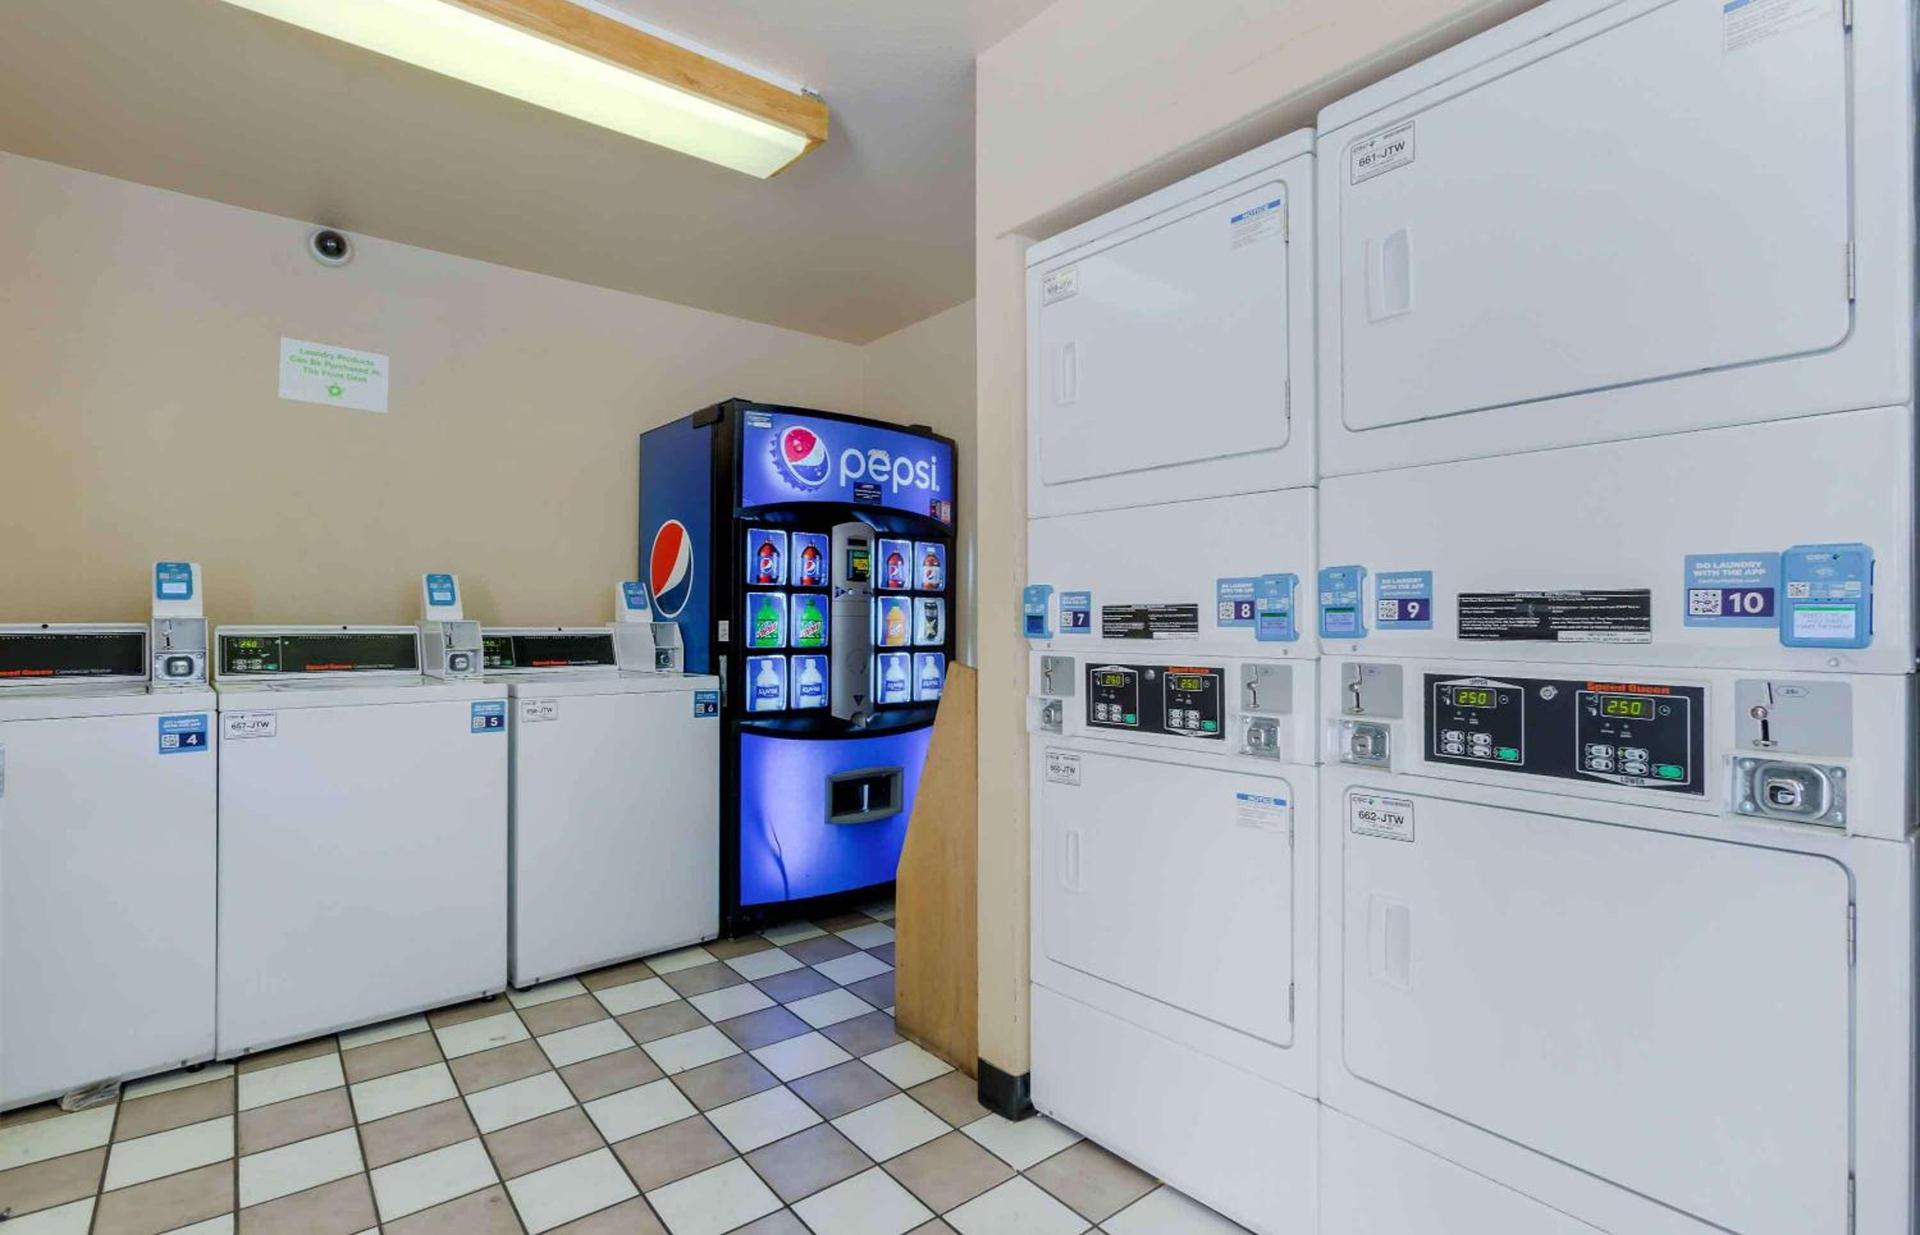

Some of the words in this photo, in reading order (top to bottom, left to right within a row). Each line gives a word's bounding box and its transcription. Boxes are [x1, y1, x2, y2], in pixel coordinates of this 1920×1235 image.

[1358, 140, 1406, 167] 661-JTW
[1713, 560, 1762, 569] LAUNDRY
[1729, 592, 1765, 614] 10
[1241, 603, 1251, 618] 8
[1407, 602, 1420, 619] 9
[1077, 613, 1085, 626] 7
[1587, 682, 1626, 692] Speed
[1628, 684, 1670, 695] Queen
[1458, 691, 1488, 705] 250
[707, 704, 714, 713] 6
[1607, 700, 1642, 716] 250
[490, 717, 498, 727] 5
[186, 734, 198, 746] 4
[1620, 776, 1646, 785] LOWER
[1358, 810, 1405, 825] 662-JTW
